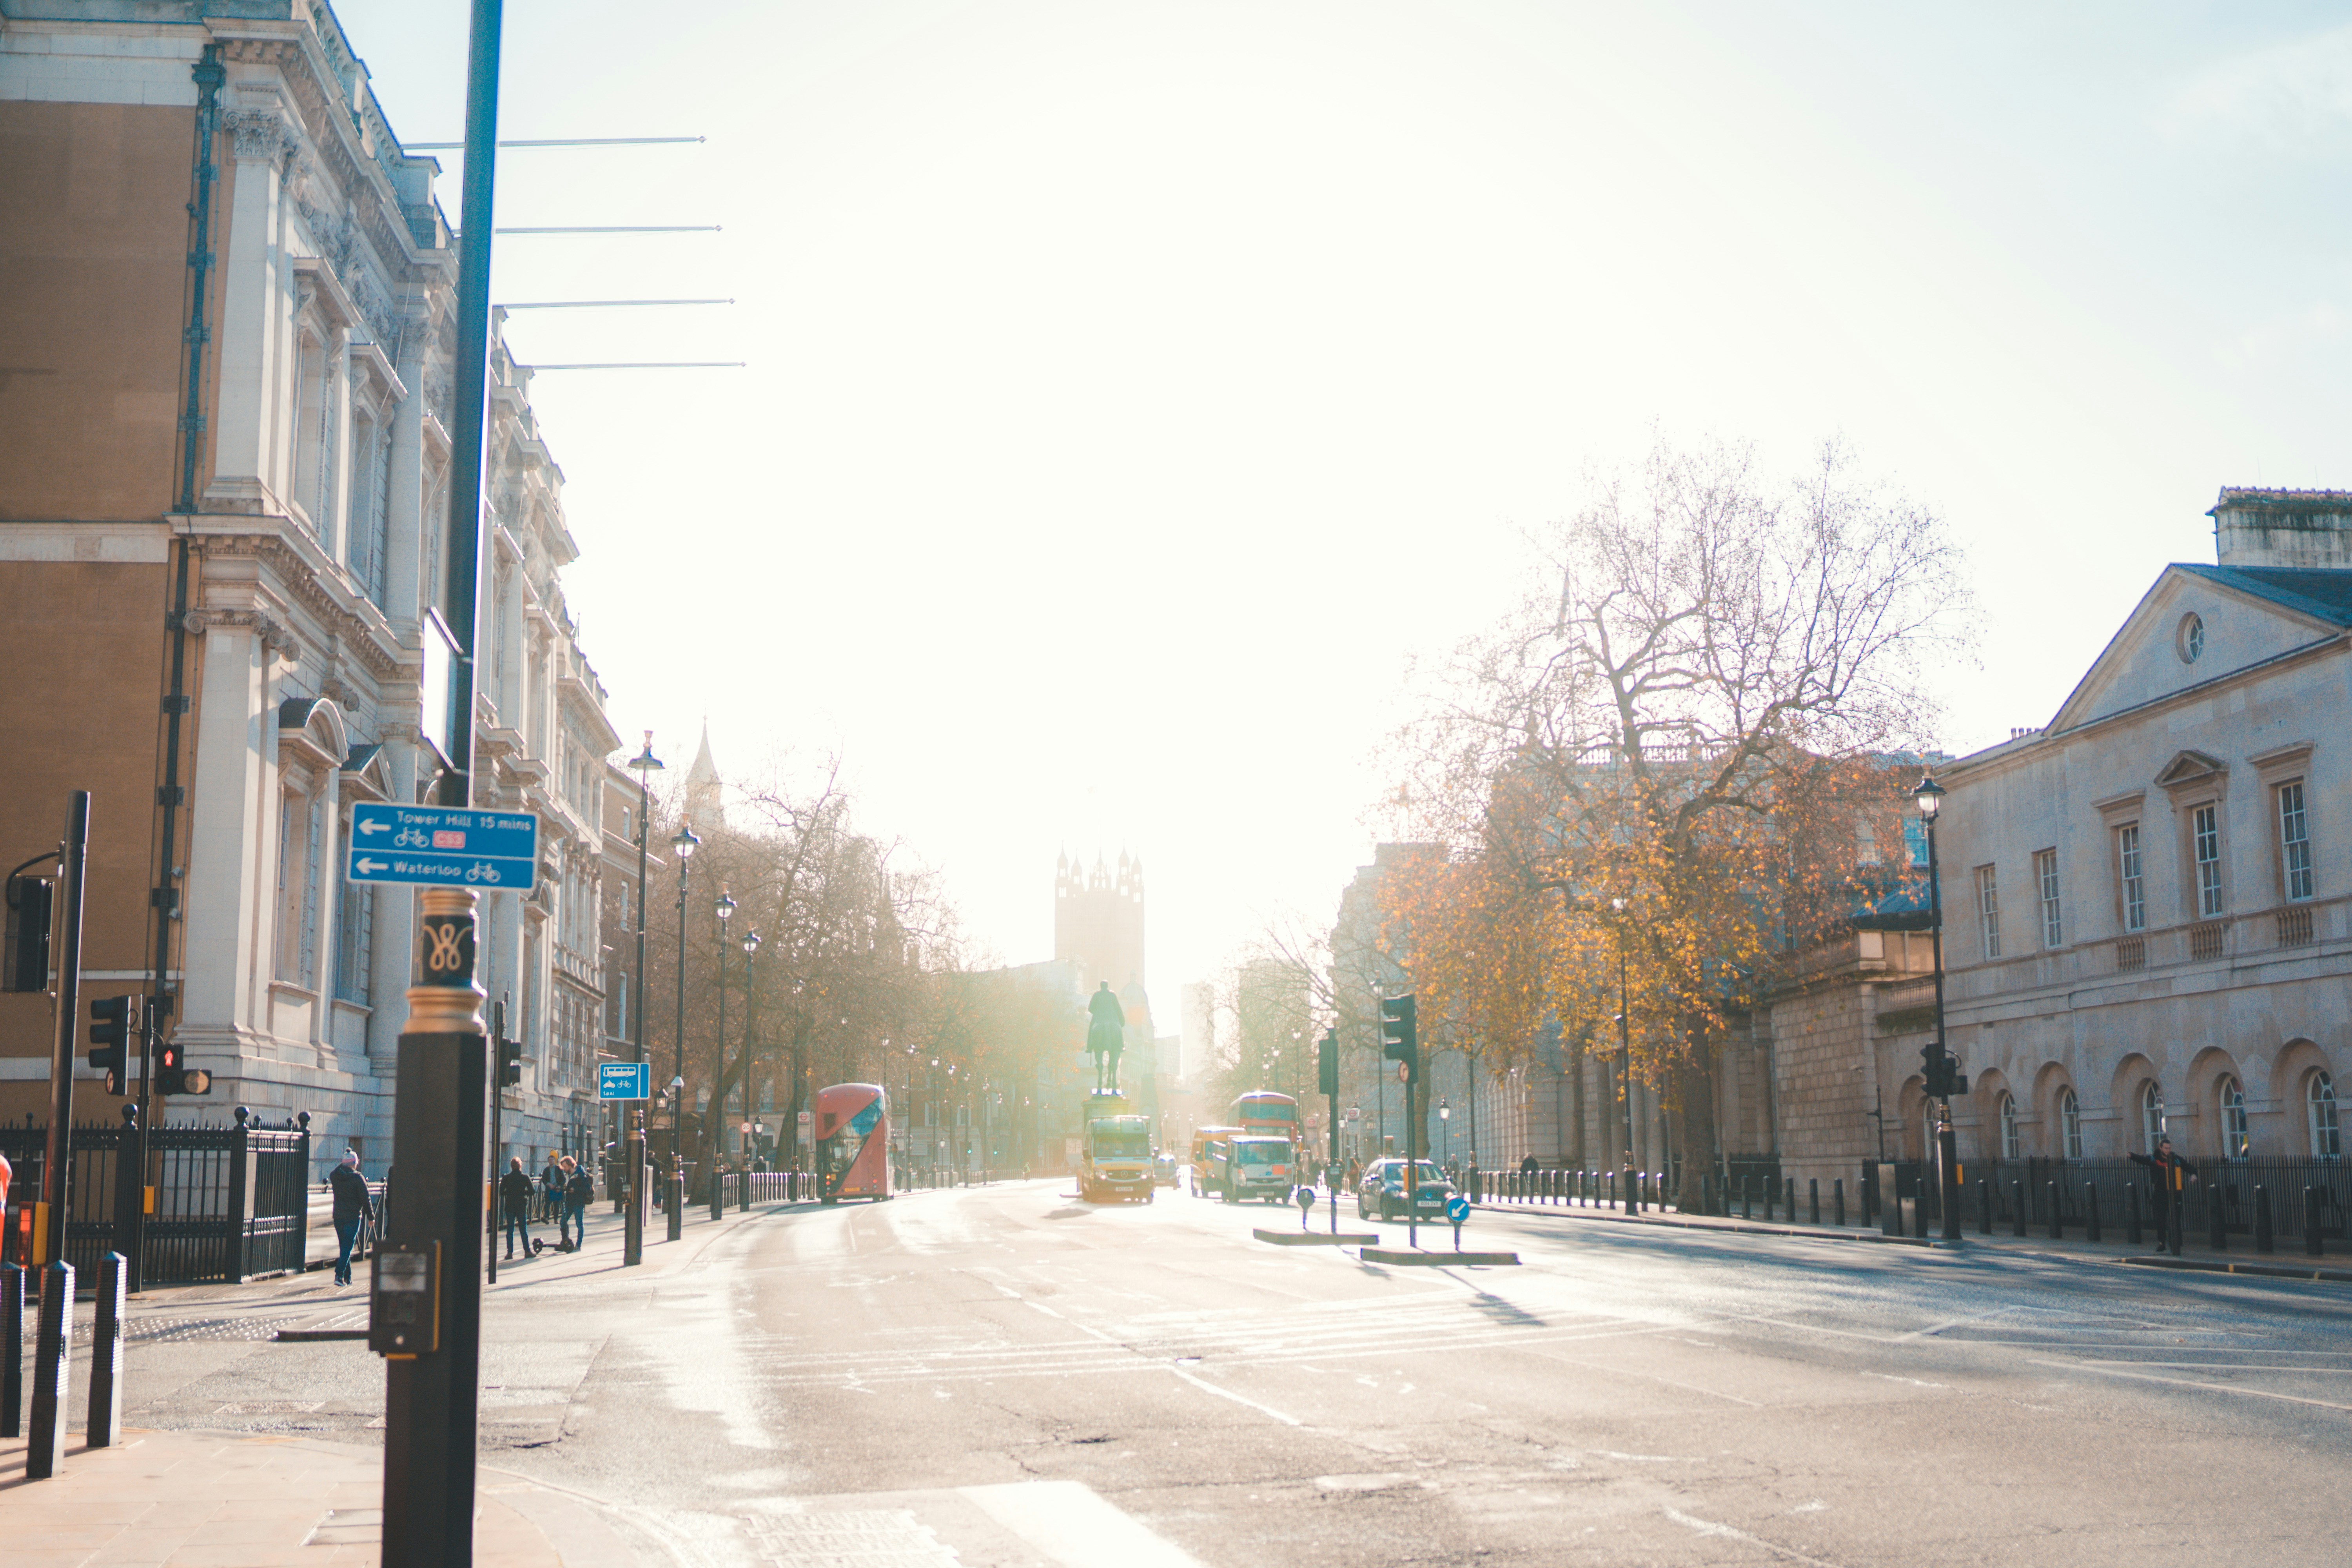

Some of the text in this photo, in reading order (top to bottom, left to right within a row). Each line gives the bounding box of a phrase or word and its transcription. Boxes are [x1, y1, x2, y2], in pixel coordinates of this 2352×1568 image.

[397, 811, 532, 831] Tower Hill 15 mins
[436, 833, 462, 845] CS3
[393, 861, 462, 877] Waterloo
